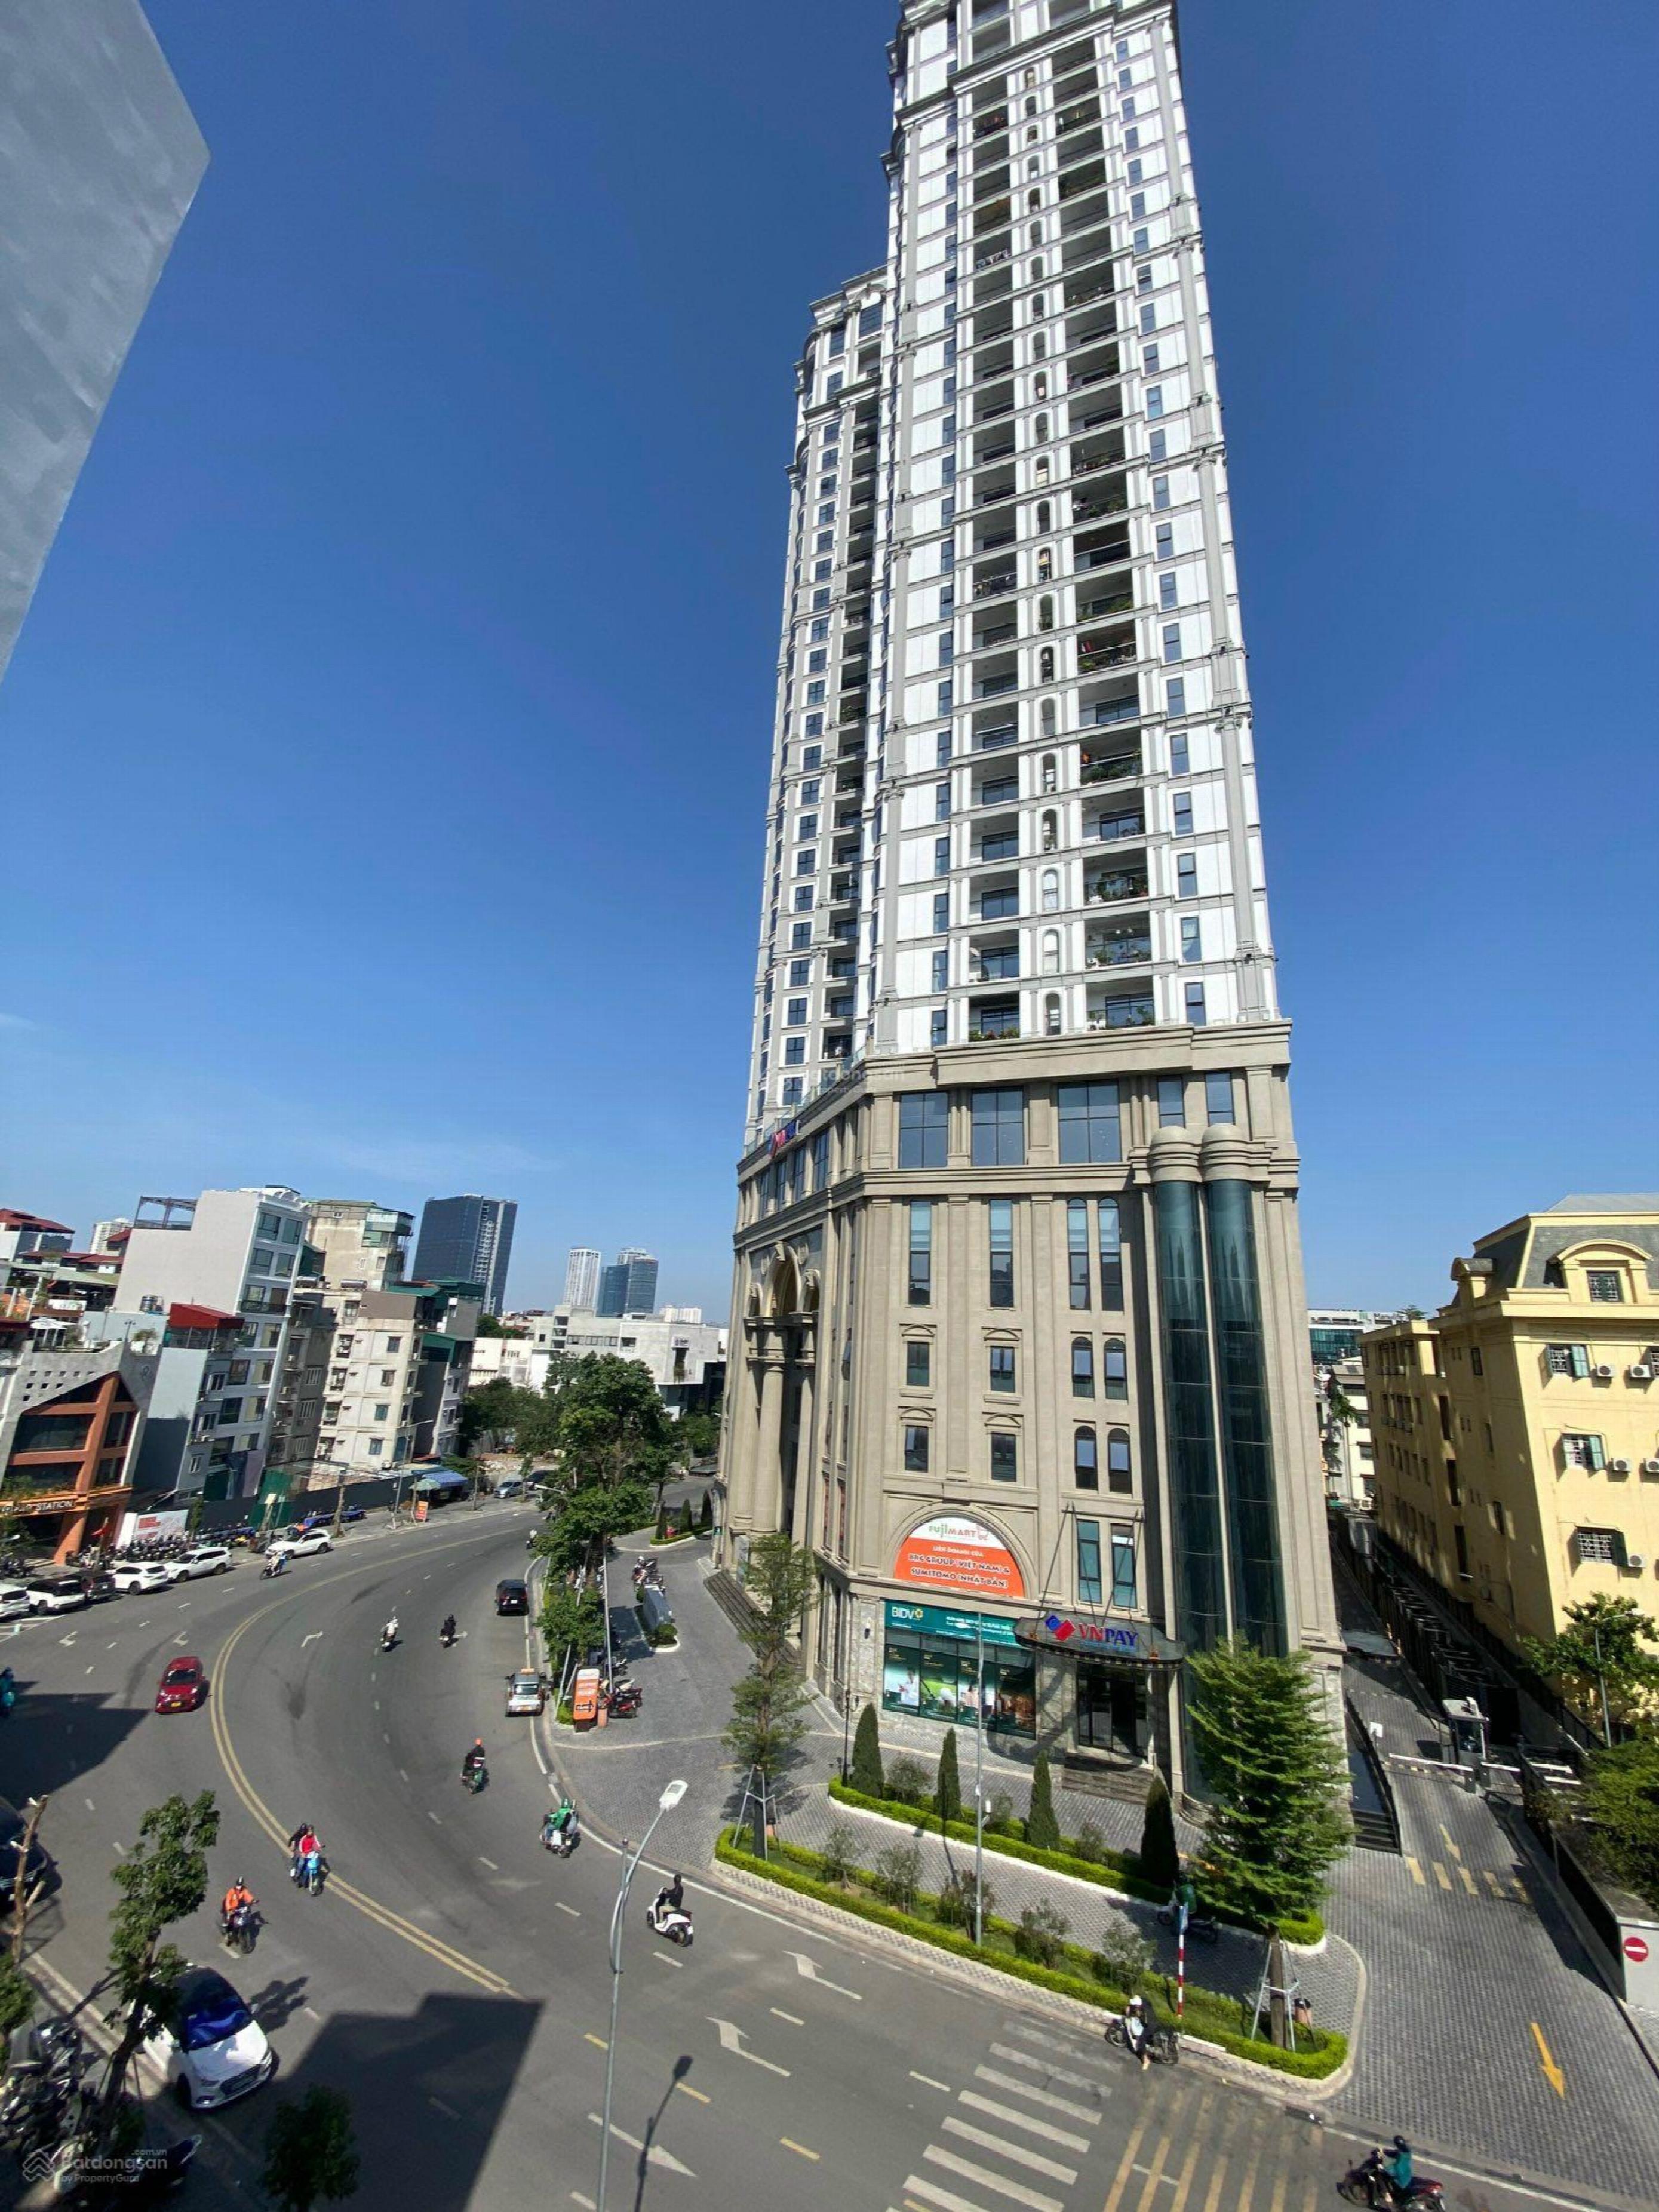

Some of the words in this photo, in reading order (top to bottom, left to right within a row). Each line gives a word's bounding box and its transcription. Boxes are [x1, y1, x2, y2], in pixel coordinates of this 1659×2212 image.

[911, 1567, 956, 1580] SUMITOMO
[892, 1606, 915, 1620] BIDV
[1079, 1623, 1138, 1646] VNPAY
